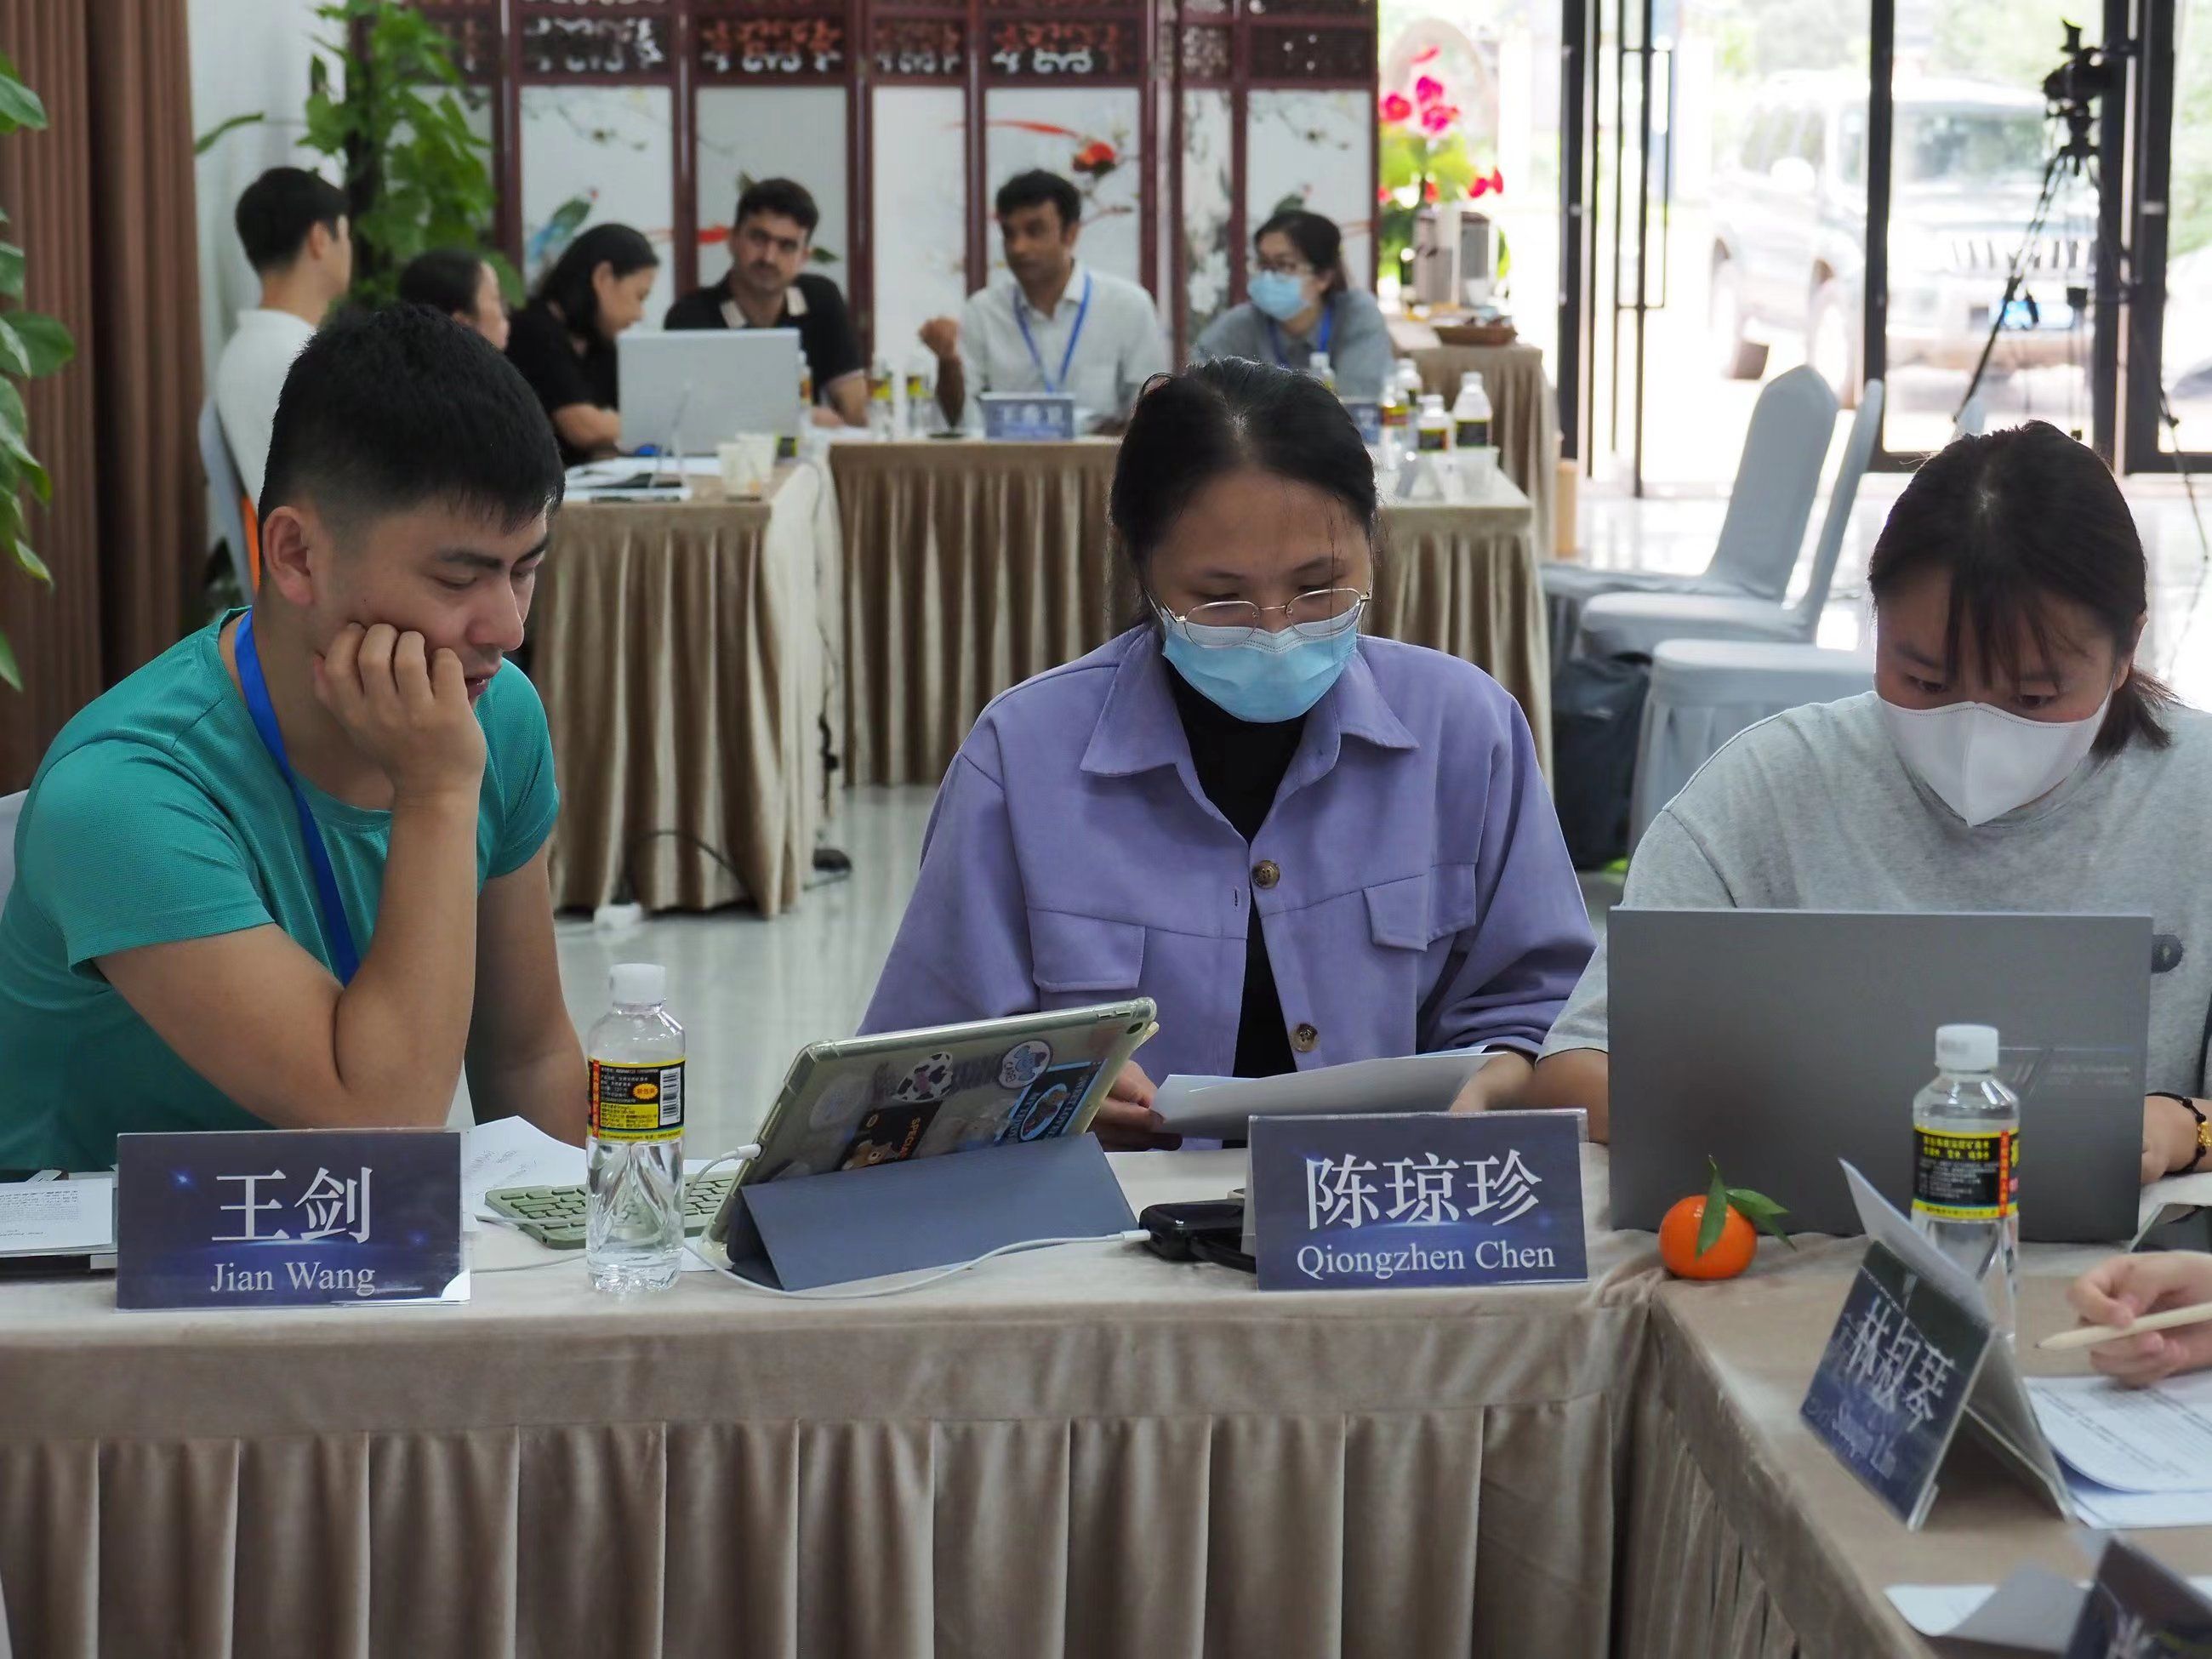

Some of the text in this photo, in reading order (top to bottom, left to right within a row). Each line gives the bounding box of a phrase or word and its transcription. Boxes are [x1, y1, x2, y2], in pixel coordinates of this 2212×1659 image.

[211, 1166, 373, 1245] 王剑
[1305, 1149, 1542, 1230] 陈琼珍
[209, 1262, 376, 1297] Jian Wang
[1297, 1240, 1556, 1280] Qiongzhen Chen
